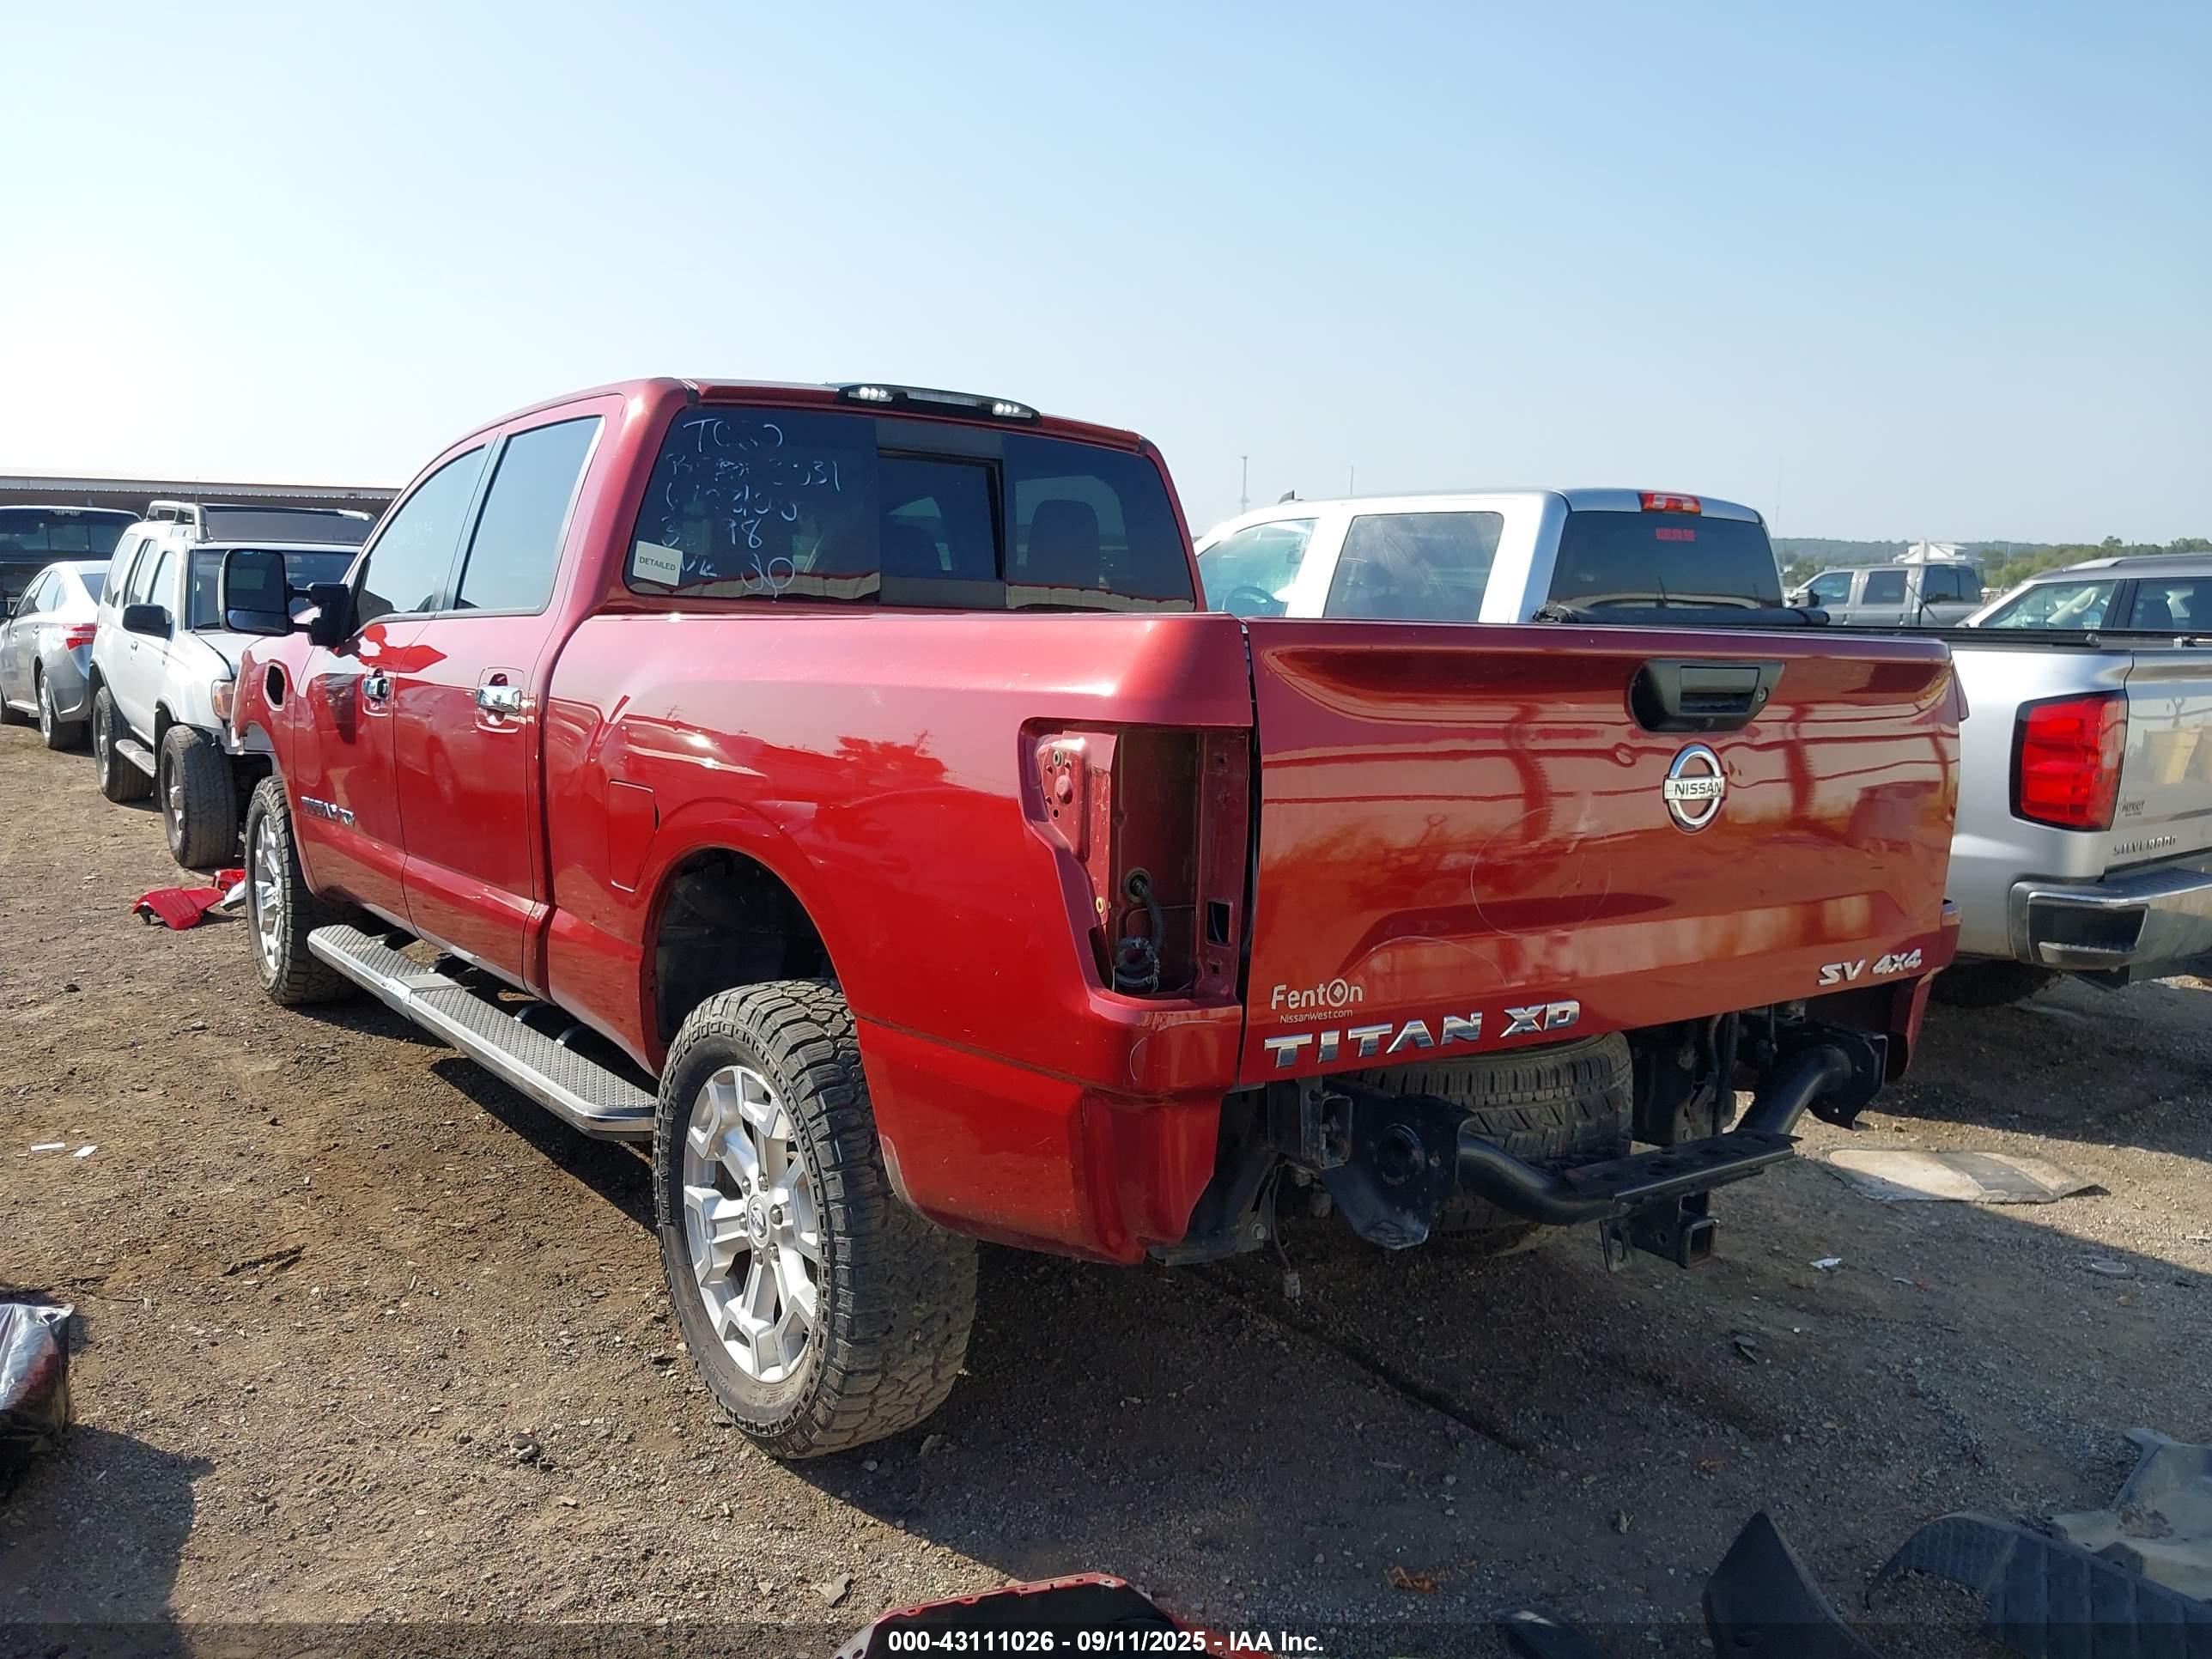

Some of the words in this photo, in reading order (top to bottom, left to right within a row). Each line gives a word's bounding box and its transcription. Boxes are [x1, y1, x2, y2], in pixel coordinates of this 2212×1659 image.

[639, 556, 677, 571] DETAILED
[1674, 781, 1723, 795] NISSAN
[1817, 959, 1866, 986] SV
[1279, 1007, 1354, 1024] NissanWest.com
[1264, 1012, 1483, 1069] TITAN
[1499, 1000, 1580, 1038] XD
